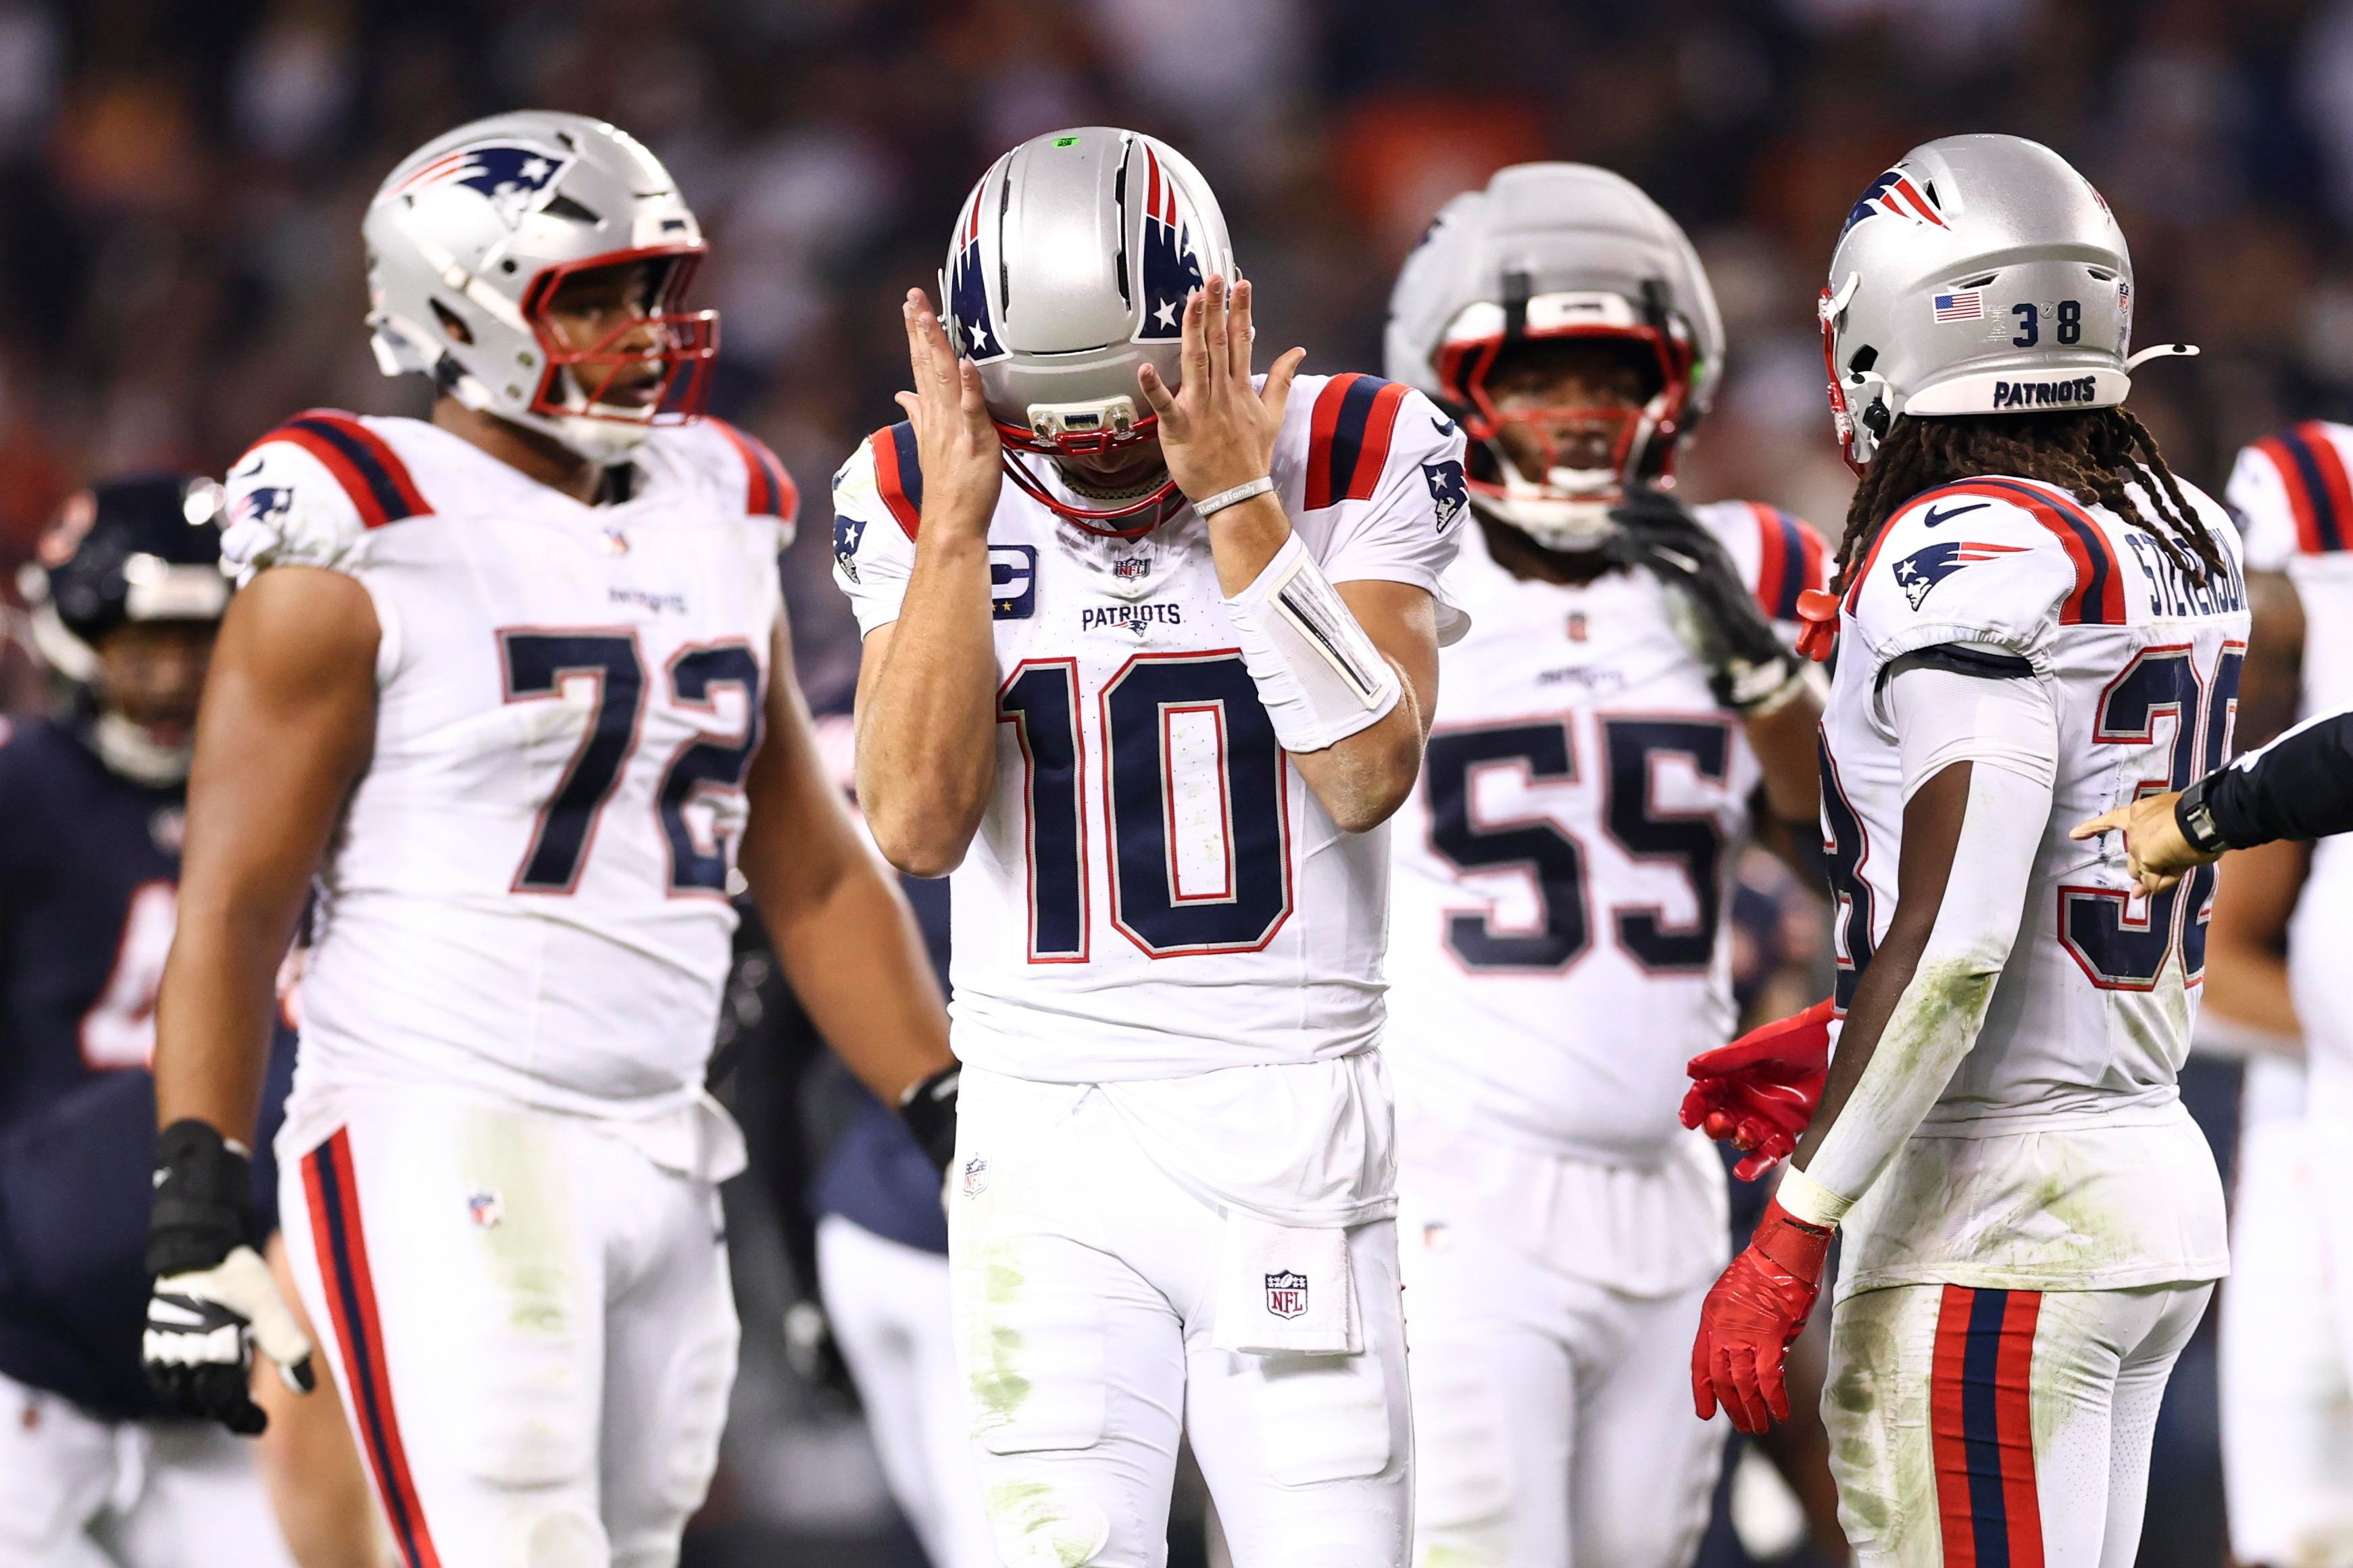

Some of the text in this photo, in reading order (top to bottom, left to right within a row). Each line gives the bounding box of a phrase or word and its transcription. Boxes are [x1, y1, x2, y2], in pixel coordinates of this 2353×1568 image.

[1993, 375, 2096, 407] PATRIOTS
[1197, 485, 1255, 514] #Love #Family
[1118, 566, 1145, 575] NFL
[1082, 603, 1181, 632] PATRIOTS
[495, 626, 766, 904] 72
[997, 647, 1293, 964] 10
[1421, 708, 1738, 978] 55
[1271, 1290, 1303, 1313] NFL
